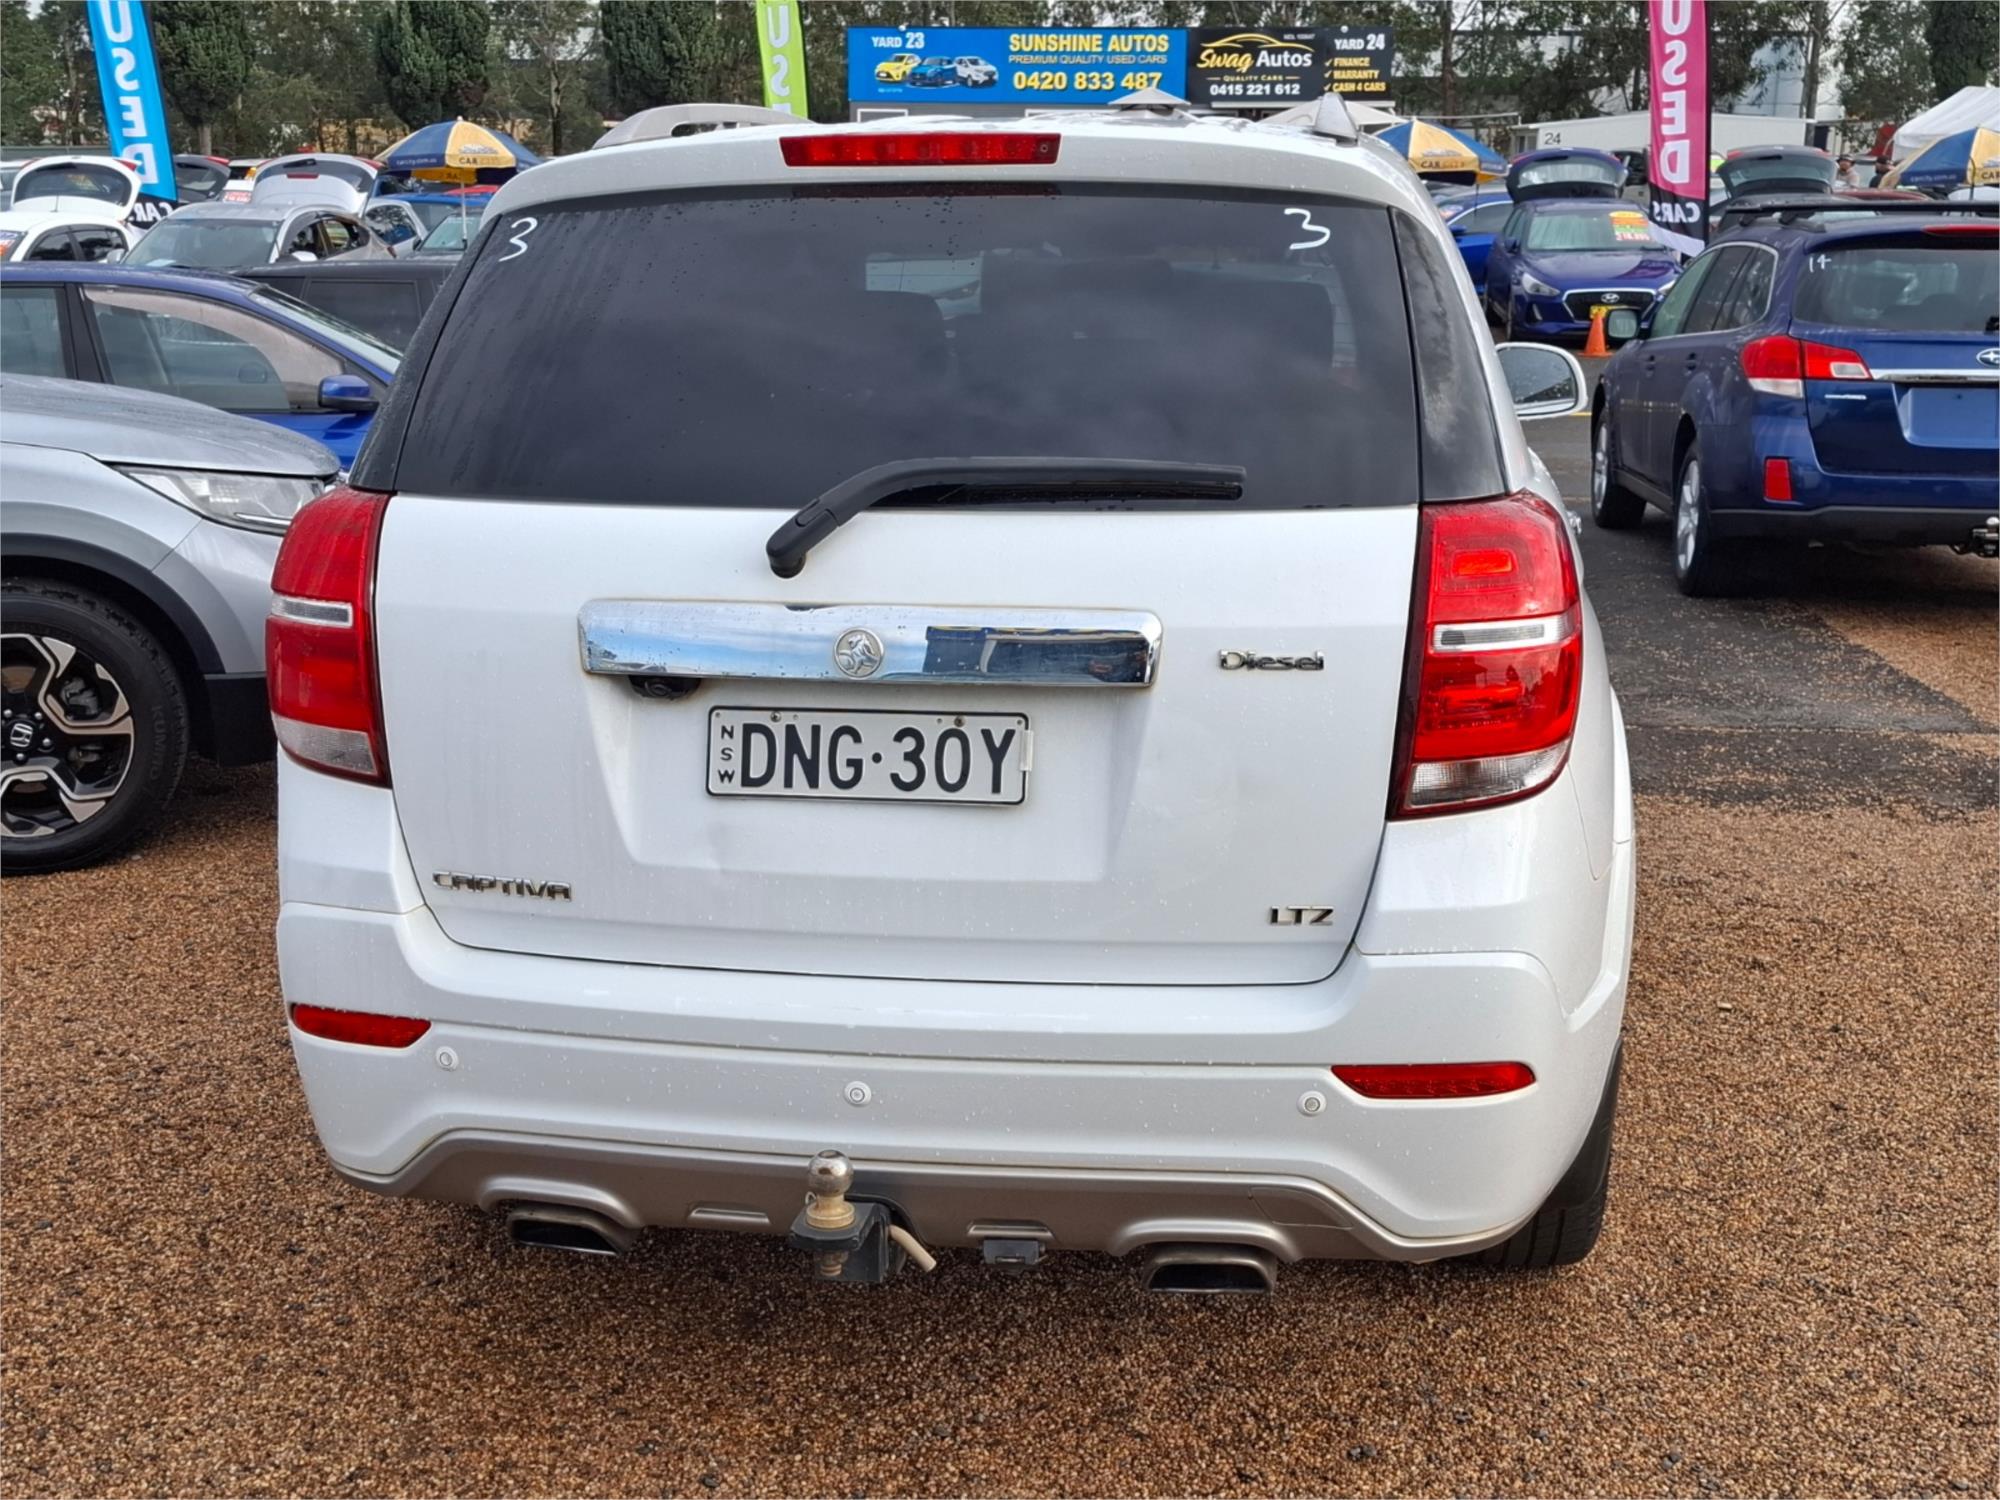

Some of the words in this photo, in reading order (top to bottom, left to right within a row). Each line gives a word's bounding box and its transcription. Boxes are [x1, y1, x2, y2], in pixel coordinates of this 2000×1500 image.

[871, 37, 902, 48] YARD
[905, 32, 925, 49] 23
[1009, 34, 1103, 52] SUNSHINE
[1108, 35, 1170, 52] AUTOS
[1334, 39, 1365, 50] YARD
[1366, 33, 1385, 50] 24
[1009, 55, 1057, 64] PREMIUM
[1060, 55, 1104, 64] QUALITY
[1107, 55, 1136, 64] USED
[1138, 55, 1168, 64] CARS
[1196, 48, 1254, 73] Swag
[1256, 50, 1312, 67] Autos
[1333, 57, 1370, 67] FINANCE
[1013, 71, 1067, 90] 0420
[1074, 72, 1115, 90] 833
[1121, 72, 1162, 90] 487
[1333, 69, 1380, 79] WARRANTY
[1209, 84, 1243, 95] 0415
[1246, 83, 1271, 95] 221
[1274, 83, 1300, 95] 612
[1332, 82, 1356, 92] CASH
[1357, 82, 1362, 91] 4
[1364, 82, 1386, 91] CARS
[1544, 133, 1561, 145] 24
[1284, 208, 1331, 250] 3
[498, 216, 538, 262] 3
[1219, 650, 1325, 671] Diesel
[432, 870, 573, 902] CAPTIVA
[1270, 905, 1334, 926] LTZ
